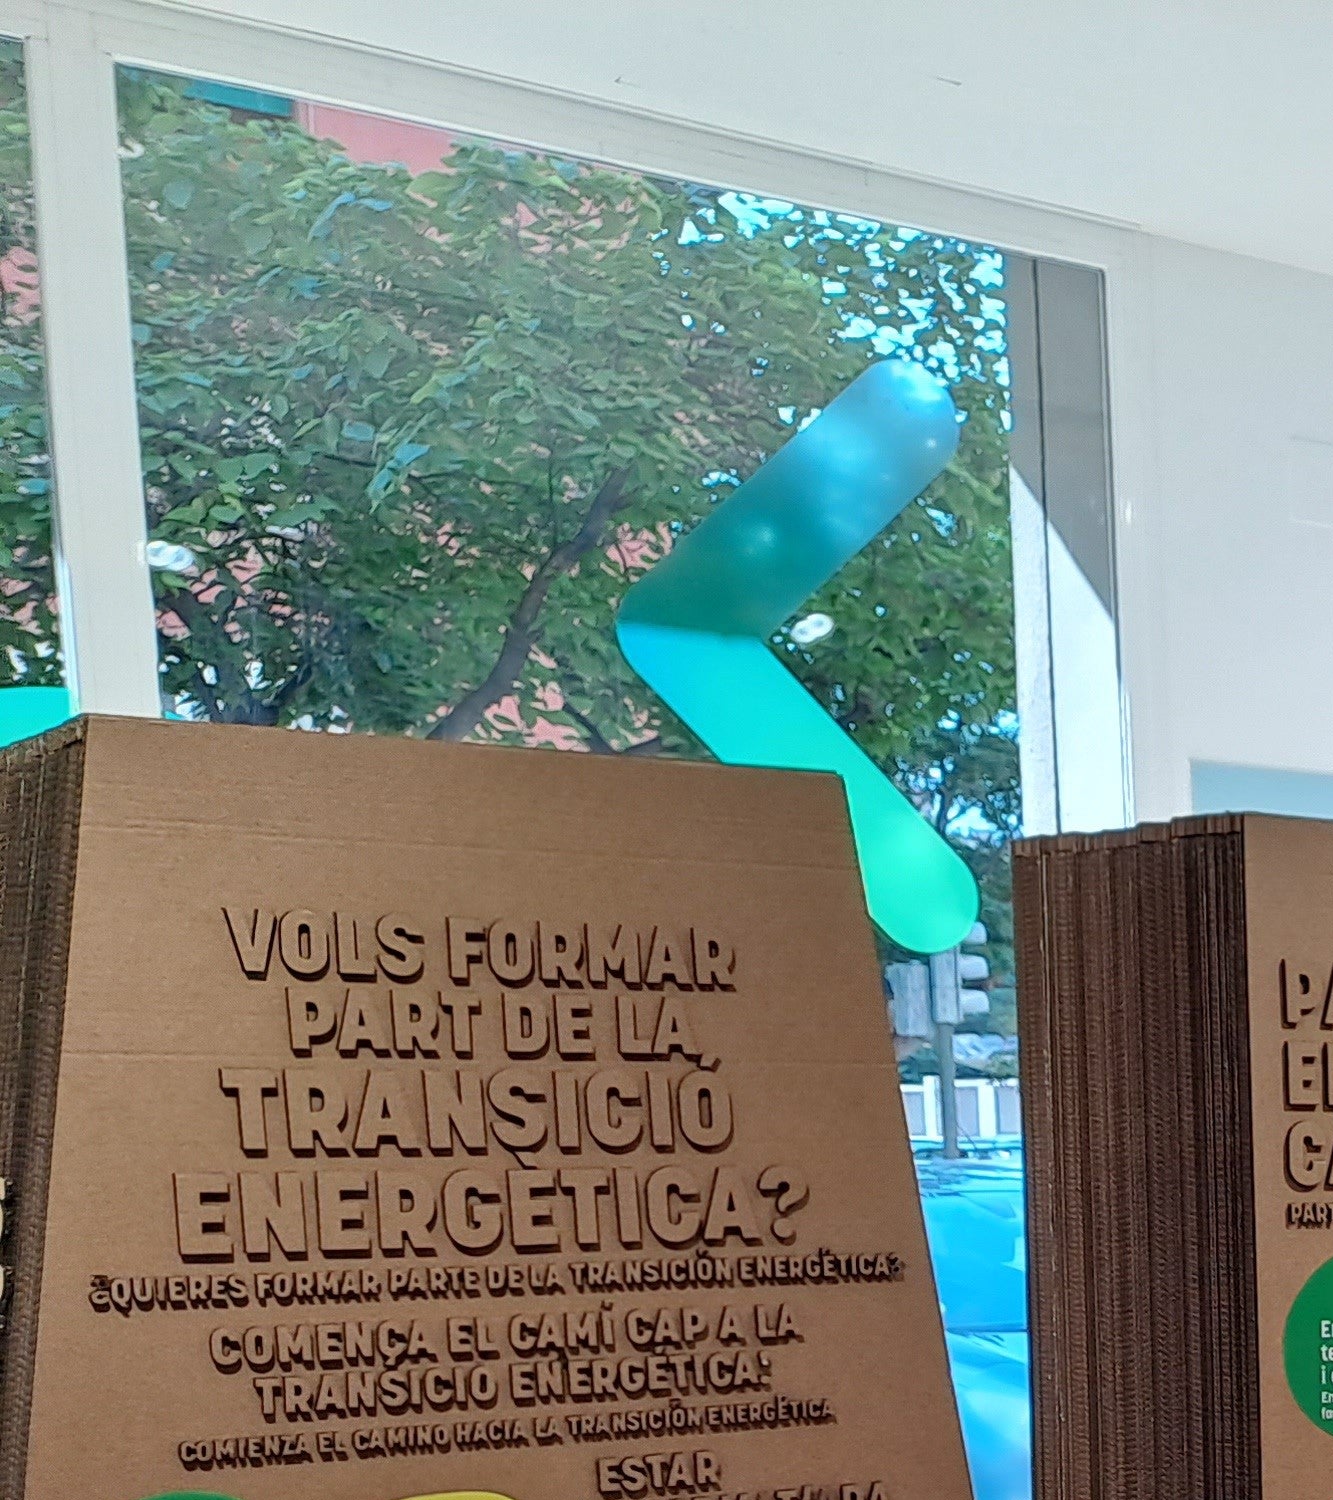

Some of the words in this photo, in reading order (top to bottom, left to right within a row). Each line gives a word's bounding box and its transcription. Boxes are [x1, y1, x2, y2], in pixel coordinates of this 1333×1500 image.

[221, 906, 424, 984] VOLS
[446, 917, 737, 993] FORMAR
[285, 988, 482, 1060] PART
[502, 996, 598, 1061] DE
[617, 996, 703, 1061] LA
[221, 1053, 734, 1158] TRANSICIÓ
[172, 1151, 809, 1264] ENERGÈTICA?
[90, 1275, 248, 1316] ¿QUIERES
[255, 1270, 383, 1310] FORMAR
[389, 1266, 482, 1302] PARTE
[486, 1263, 525, 1298] DE
[528, 1260, 565, 1295] LA
[569, 1249, 733, 1293] TRANSICIÓN
[739, 1247, 905, 1286] ENERGÉTICA?
[209, 1320, 438, 1375] COMENÇA
[446, 1315, 500, 1362] EL
[507, 1300, 615, 1357] CAMÍ
[625, 1306, 709, 1349] CAP
[718, 1304, 747, 1346] A
[754, 1302, 805, 1345] LA
[1321, 1366, 1327, 1384] i
[178, 1433, 312, 1471] COMIENZA
[317, 1432, 348, 1462] EL
[352, 1424, 453, 1460] CAMINO
[453, 1417, 529, 1452] HACIA
[533, 1416, 565, 1447] LA
[567, 1398, 702, 1443] TRANSICIÓN
[706, 1396, 840, 1436] ENERGÉTICA
[596, 1450, 722, 1499] ESTAR
